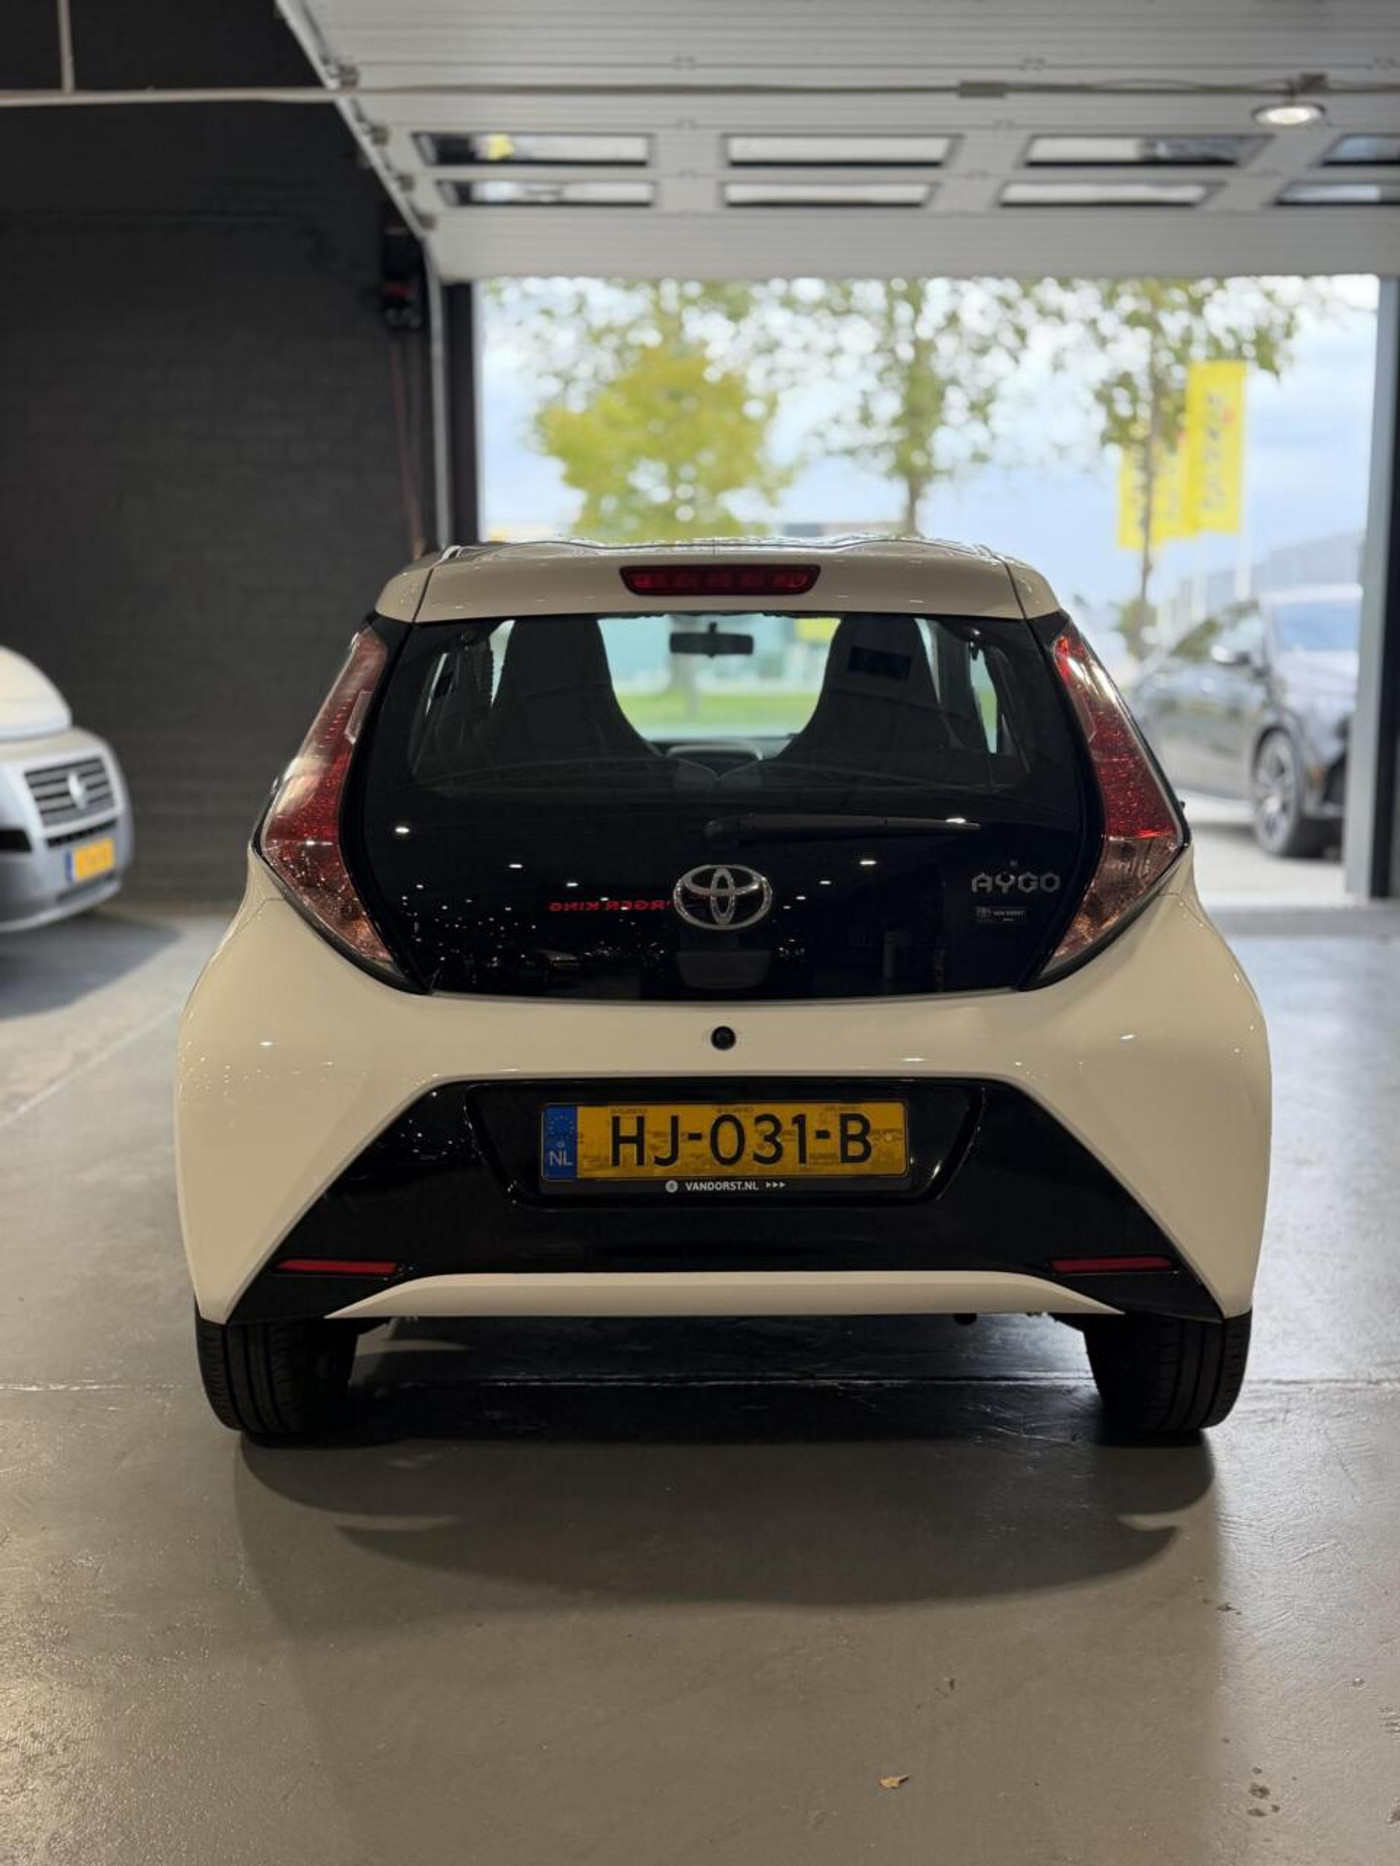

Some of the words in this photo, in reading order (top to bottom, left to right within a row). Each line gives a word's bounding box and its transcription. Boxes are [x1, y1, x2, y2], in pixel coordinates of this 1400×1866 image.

[971, 872, 1060, 894] AYGO
[611, 1113, 872, 1166] HJ-031-B
[549, 1149, 573, 1167] NL
[685, 1181, 760, 1192] VANDORST.NL
